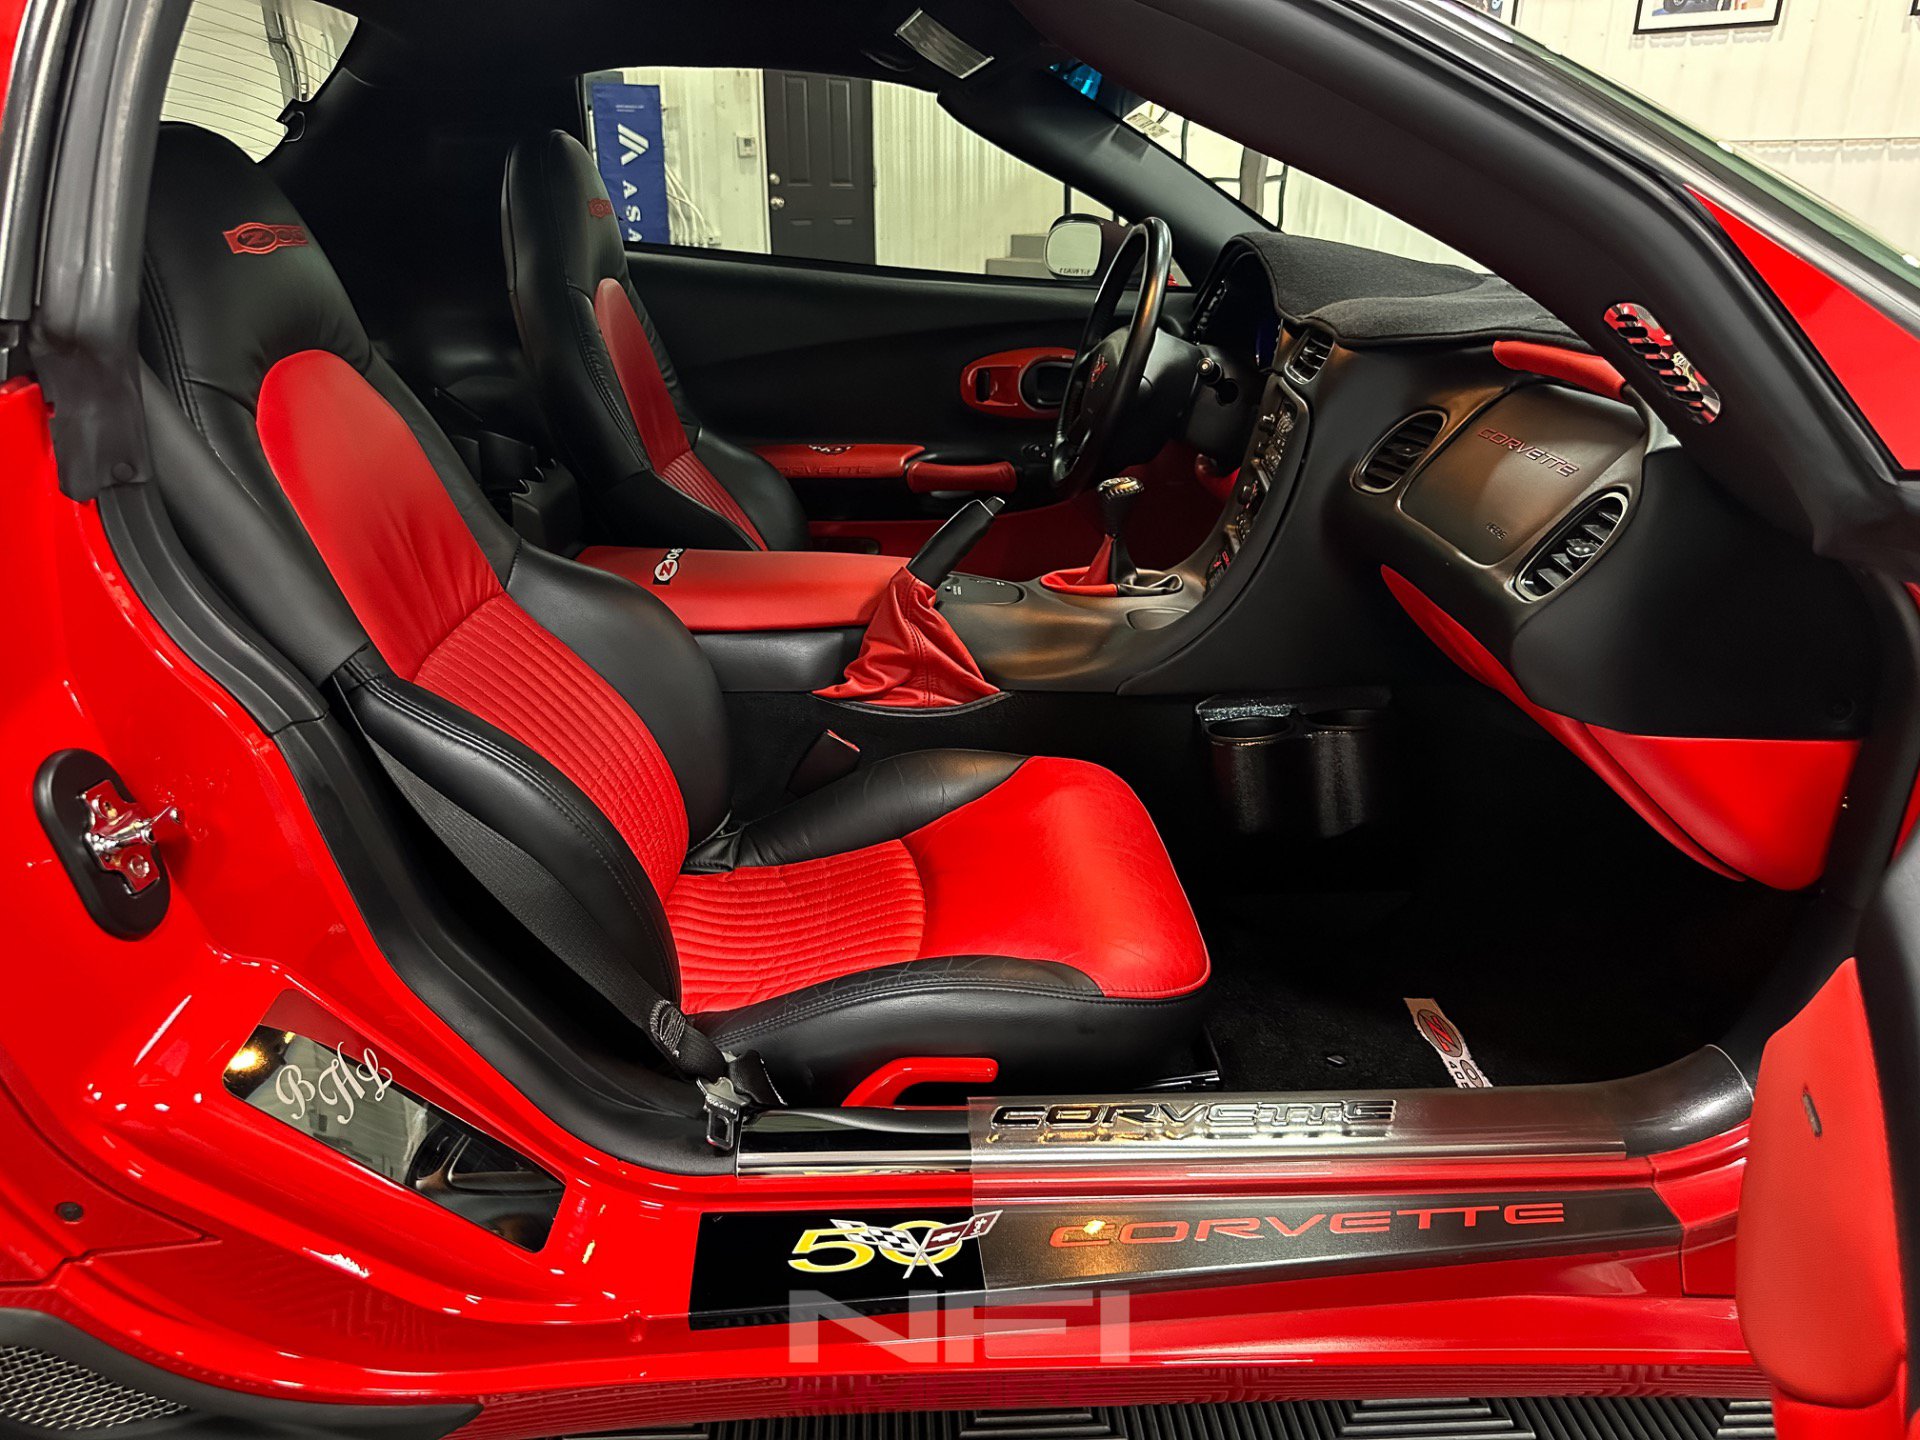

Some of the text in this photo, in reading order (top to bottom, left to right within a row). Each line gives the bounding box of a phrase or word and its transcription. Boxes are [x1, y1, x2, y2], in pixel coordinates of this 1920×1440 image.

[1478, 427, 1579, 477] CORVETTE
[990, 1099, 1397, 1128] CORVETTE
[787, 1220, 963, 1273] 50
[1049, 1202, 1565, 1248] CORVETTE
